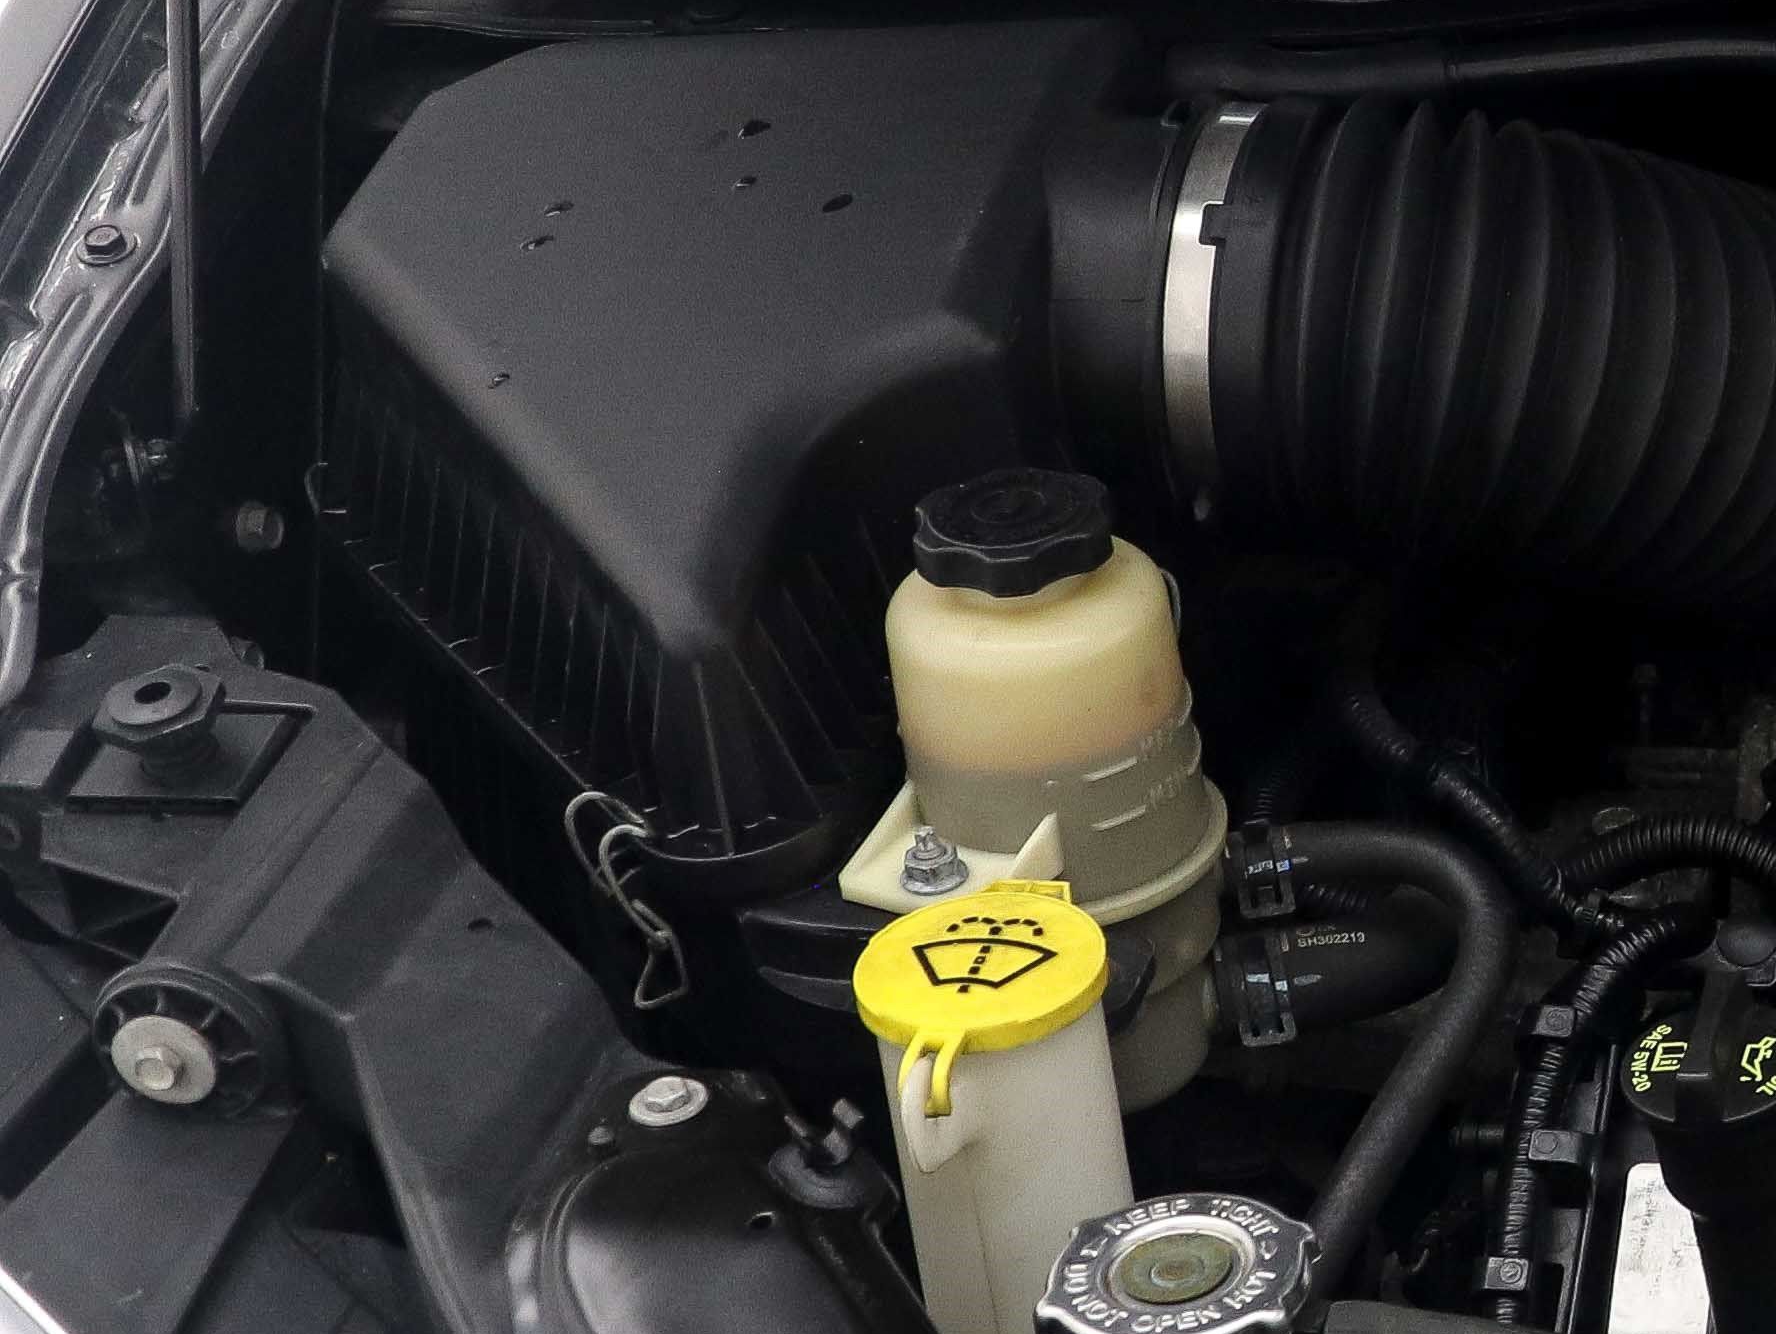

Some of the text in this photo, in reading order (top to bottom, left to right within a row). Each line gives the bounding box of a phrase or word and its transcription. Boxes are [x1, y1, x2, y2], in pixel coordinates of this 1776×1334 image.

[1631, 1024, 1672, 1092] SAE 5W-20
[1104, 1198, 1190, 1236] KEEP
[1071, 1295, 1129, 1327] NOT
[1131, 1305, 1222, 1333] OPEN
[1223, 1271, 1277, 1309] HOT
